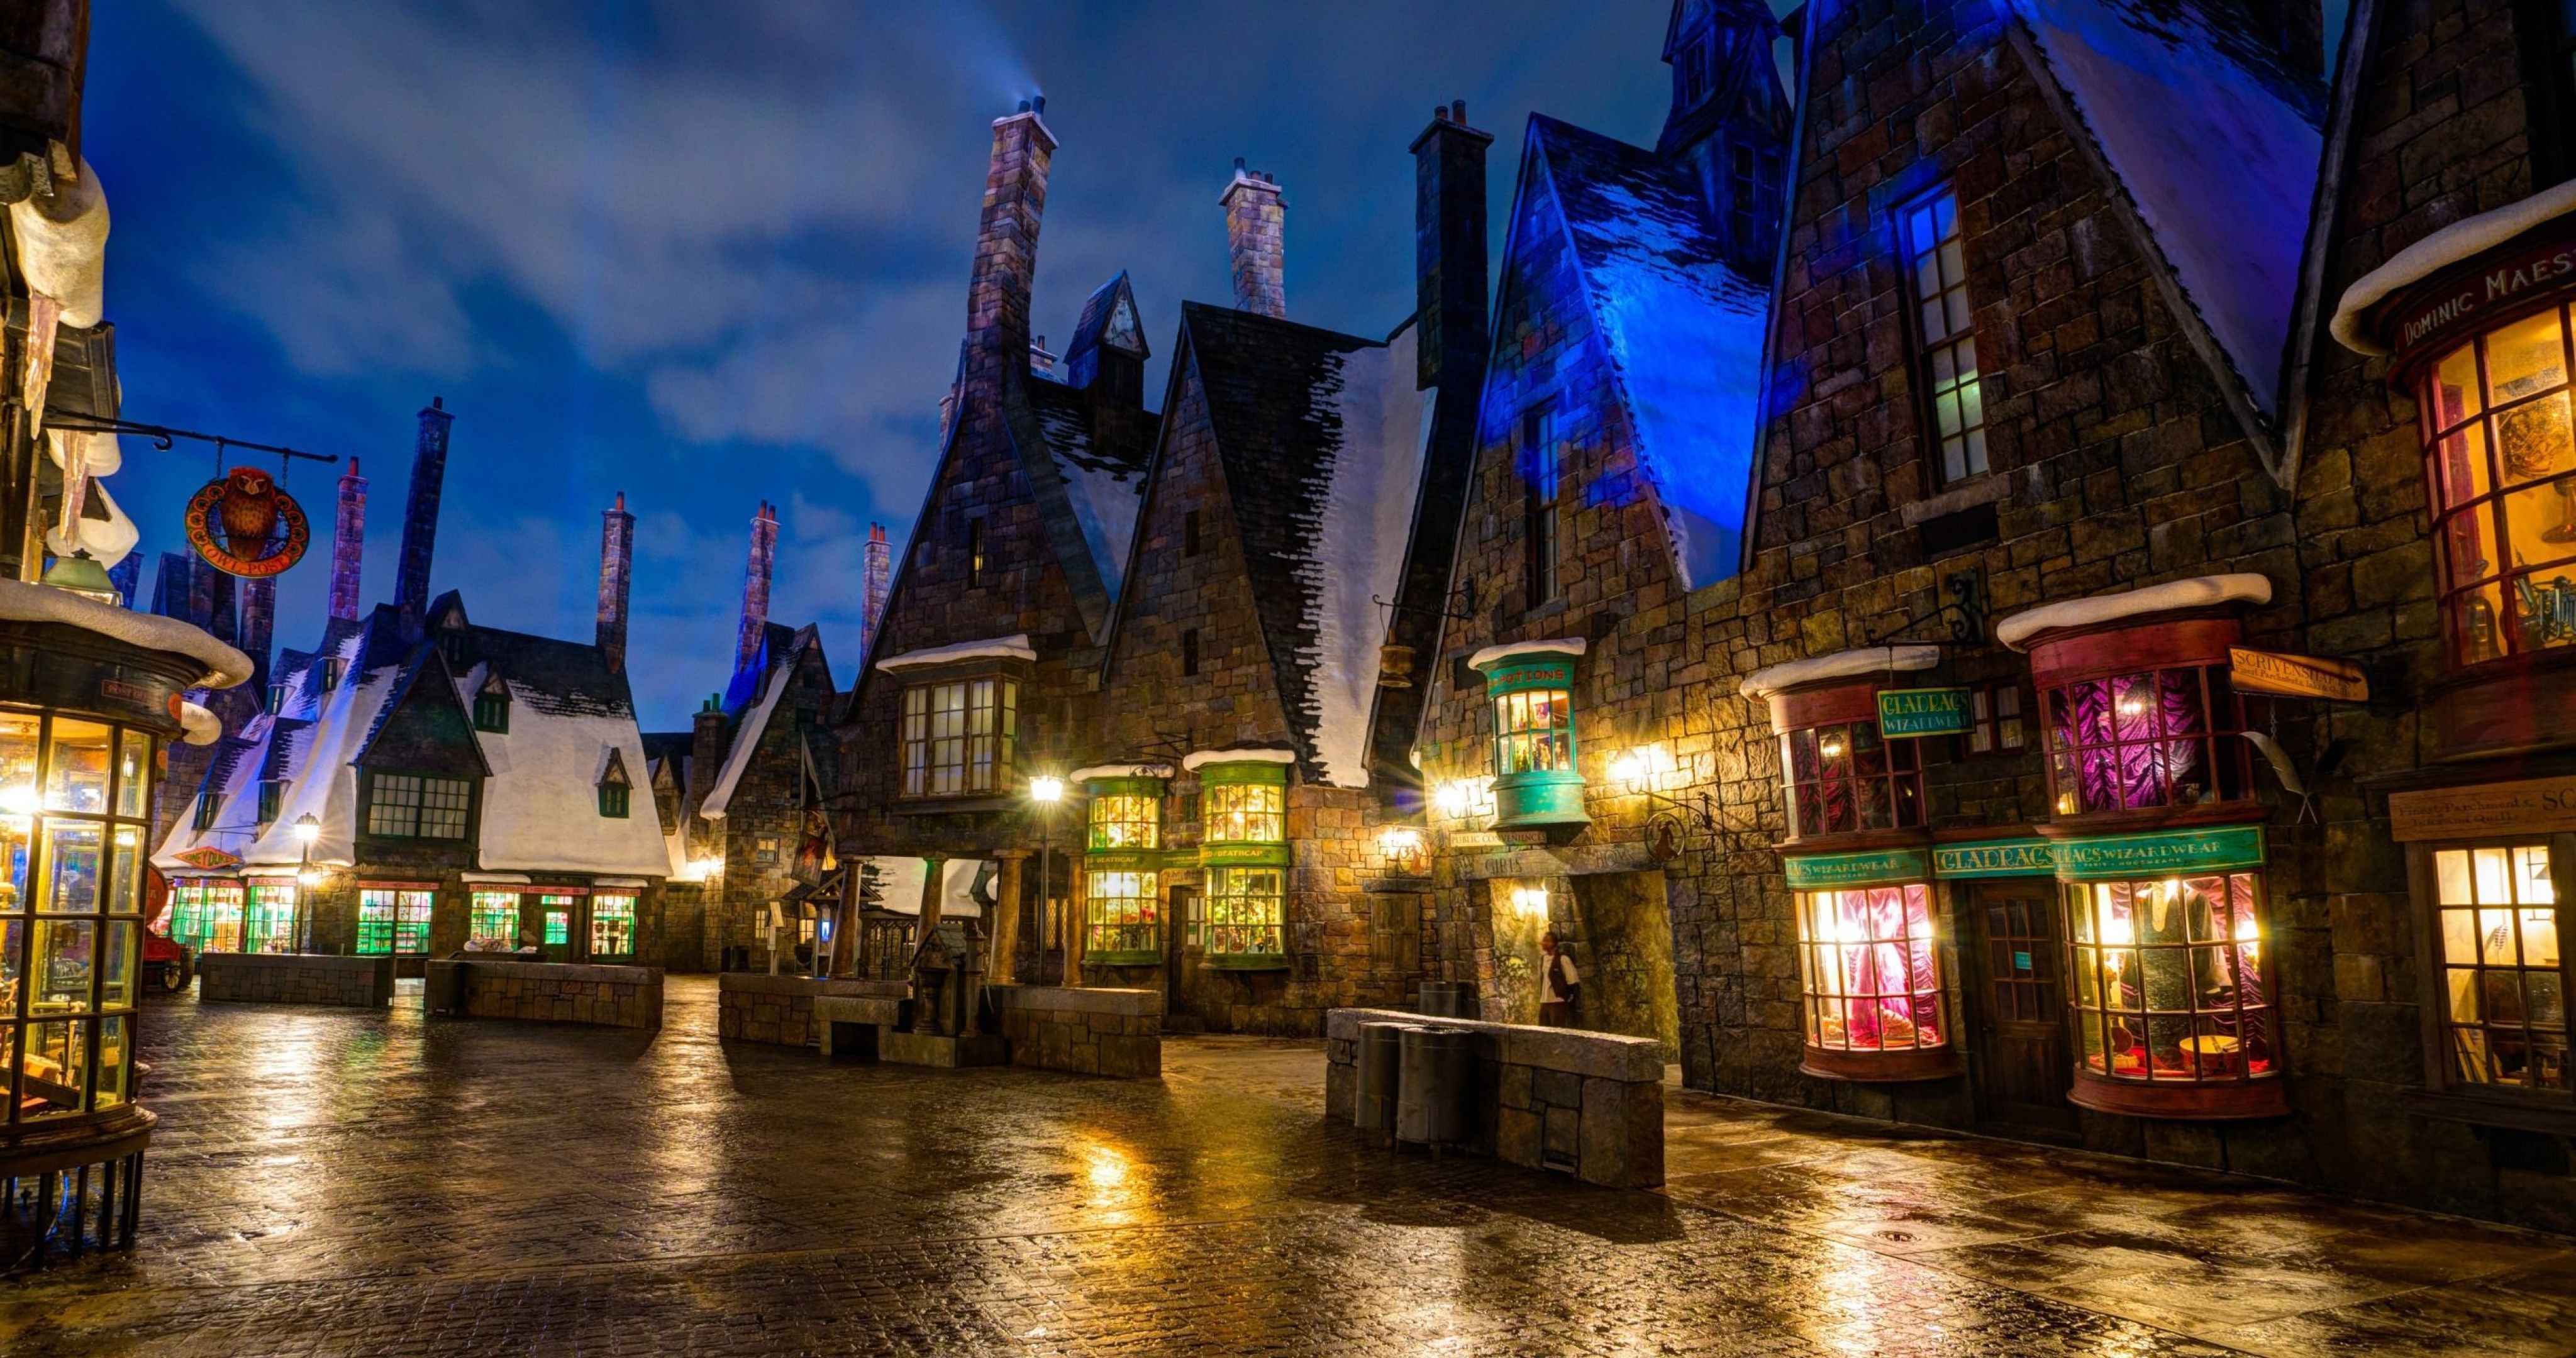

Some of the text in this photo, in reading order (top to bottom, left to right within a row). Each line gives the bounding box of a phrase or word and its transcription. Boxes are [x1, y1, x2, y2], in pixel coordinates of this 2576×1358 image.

[2404, 249, 2576, 346] DOMINIC MAES
[206, 548, 288, 573] OWL POST
[1499, 669, 1565, 683] POTIONS
[1883, 693, 1968, 715] GLADRAGS
[1452, 832, 1546, 844] PUBLIC CONVENIENCES
[1941, 847, 2054, 870] GLADRAGS
[2103, 841, 2220, 859] WIZARDWEAR
[1485, 857, 1523, 875] GIRLS
[1813, 859, 1897, 873] WIZARDWEAR
